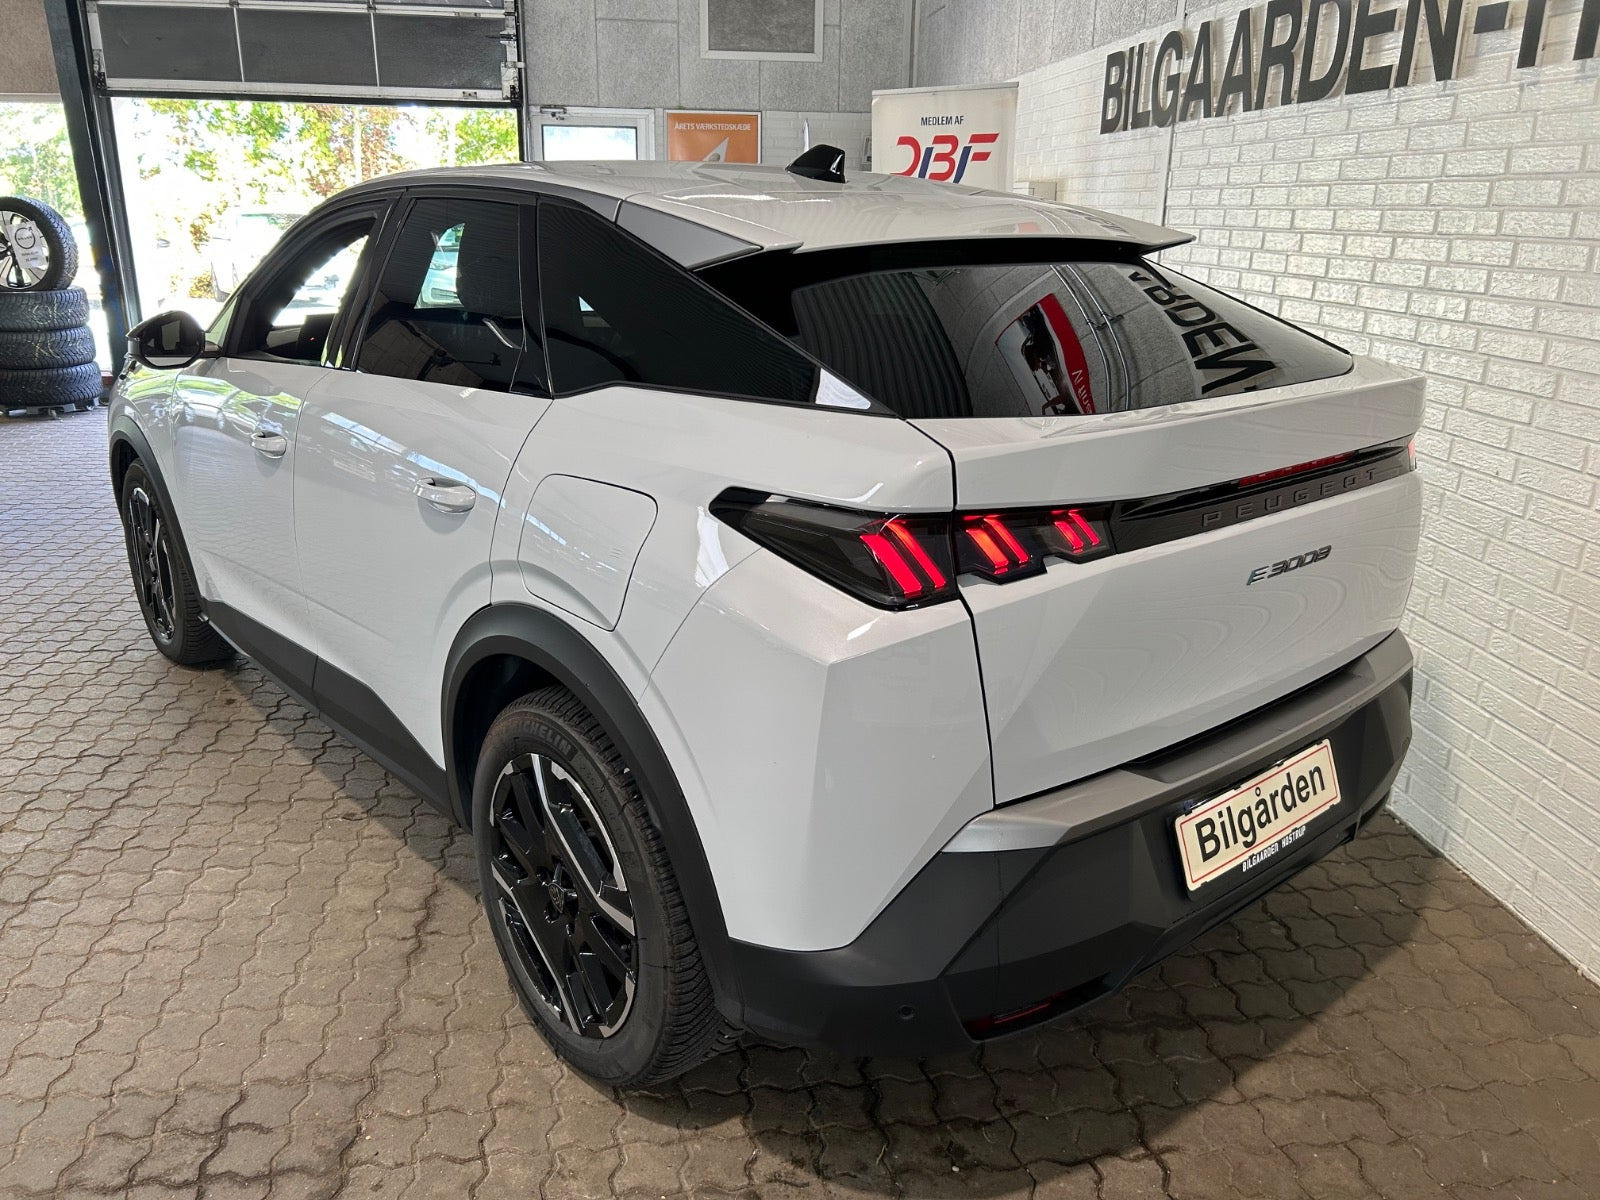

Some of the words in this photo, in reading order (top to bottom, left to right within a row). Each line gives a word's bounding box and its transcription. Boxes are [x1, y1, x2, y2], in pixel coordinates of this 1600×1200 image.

[675, 121, 696, 130] ÅRETS
[920, 115, 953, 126] MEDLEM
[954, 115, 965, 125] AF
[1202, 467, 1377, 528] PEUGEOT
[1195, 766, 1326, 863] Bilgården
[1242, 842, 1279, 873] BILGAARDEN
